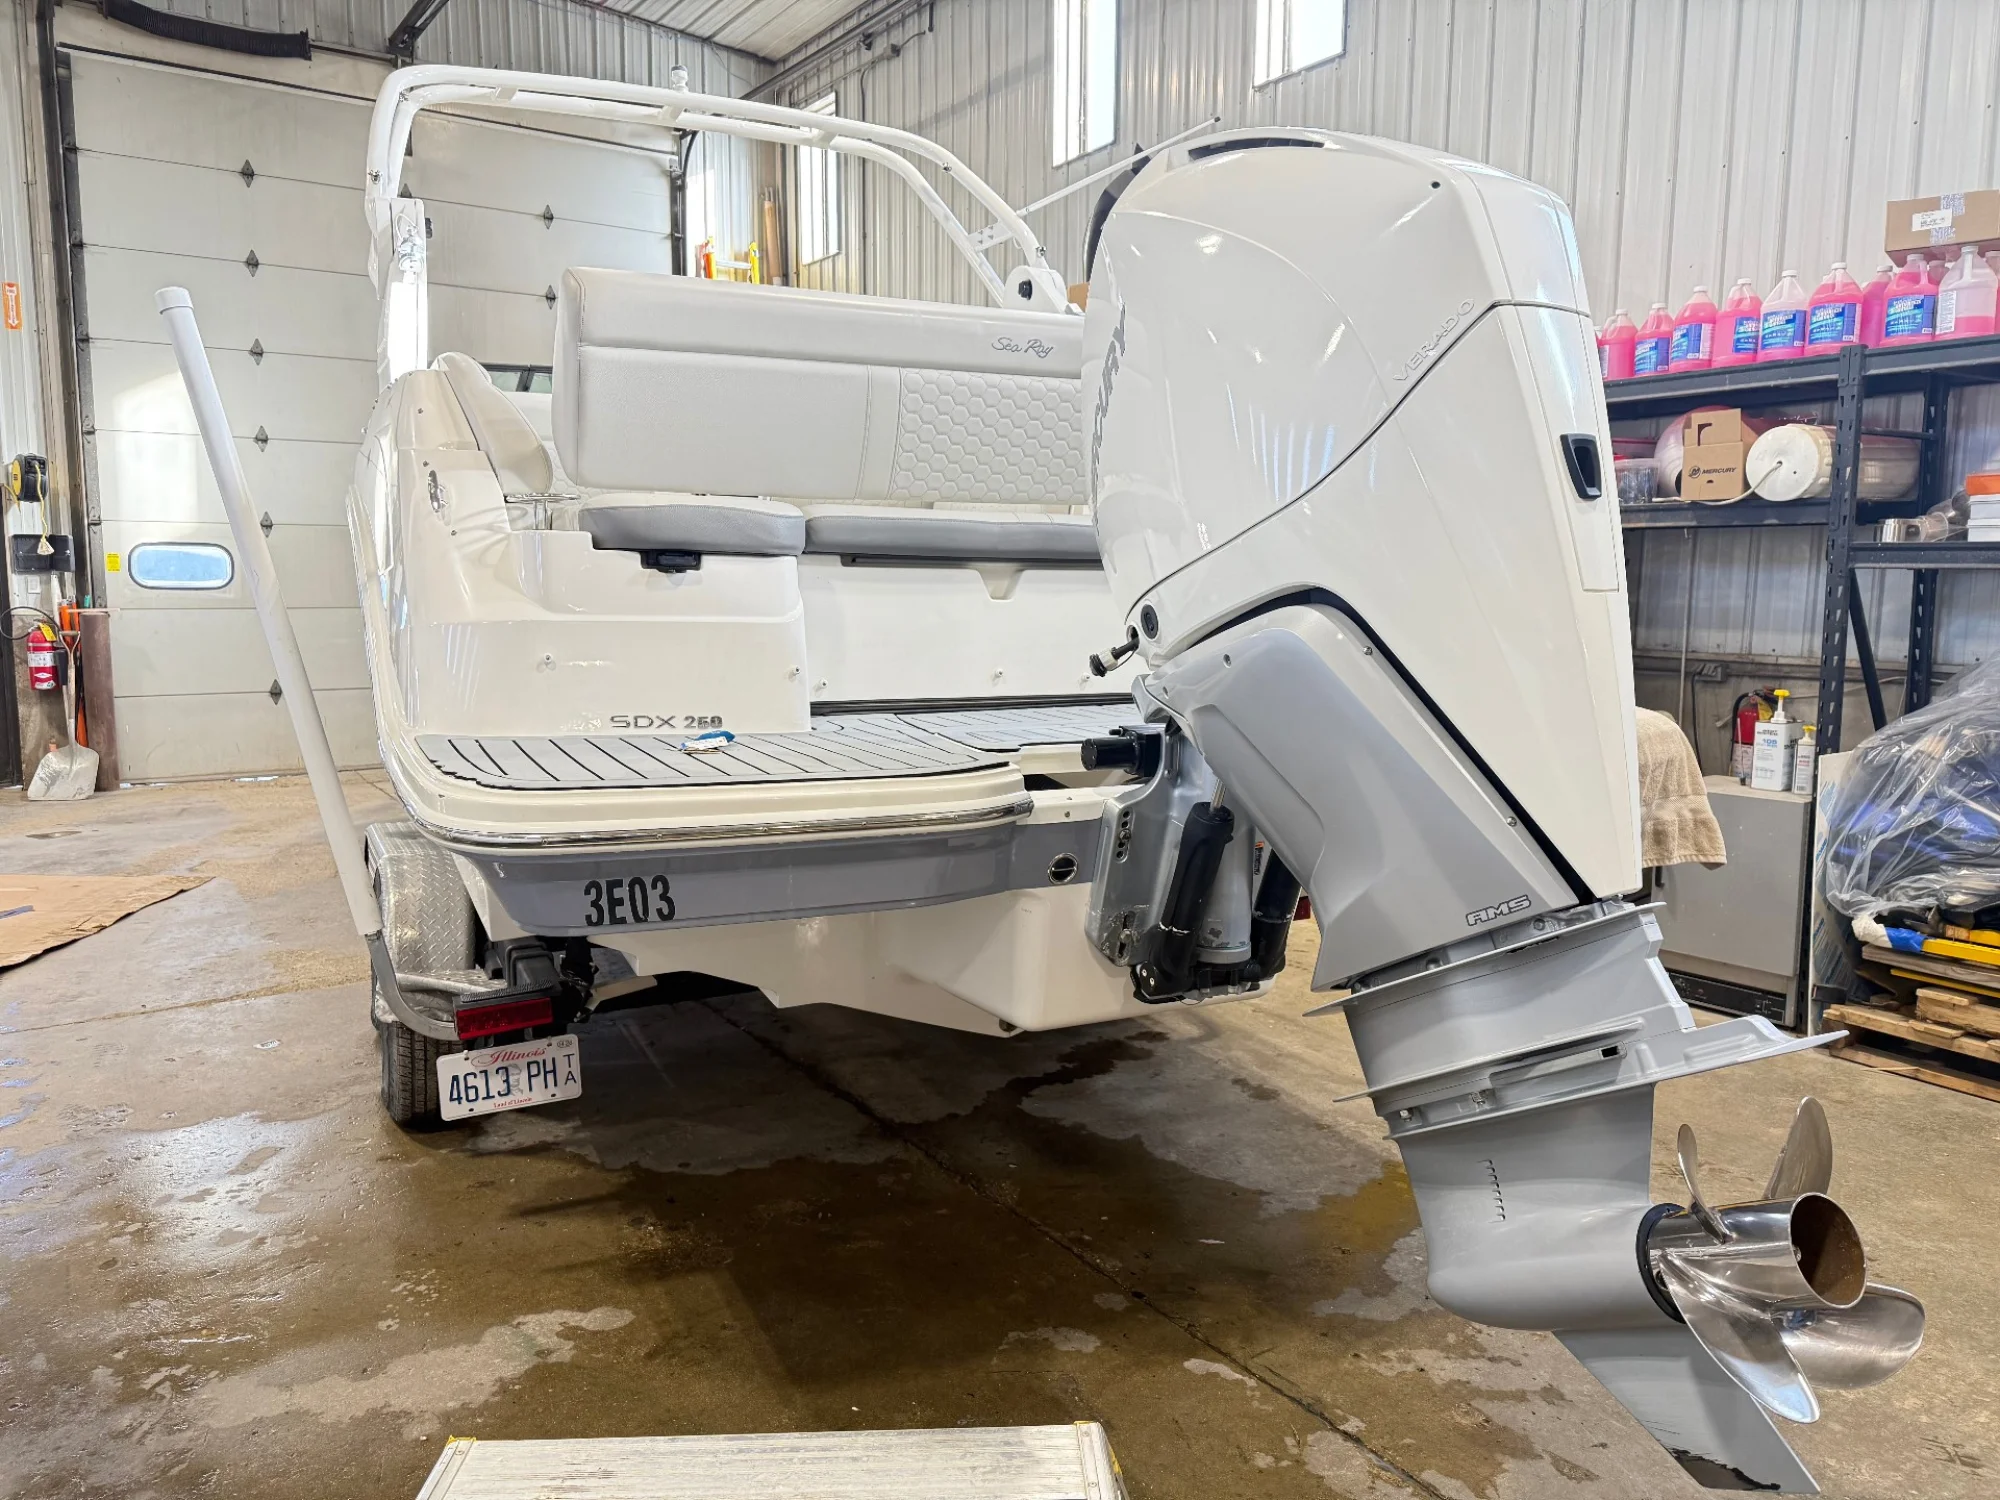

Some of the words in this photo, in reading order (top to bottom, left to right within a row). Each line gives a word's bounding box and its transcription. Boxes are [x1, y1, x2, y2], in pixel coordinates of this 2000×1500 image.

[991, 336, 1022, 352] Sea
[1024, 338, 1054, 359] Ray
[1392, 298, 1475, 381] VERADO
[1091, 302, 1126, 537] RCURY
[609, 715, 677, 729] SDX
[583, 874, 676, 927] 3E03
[1465, 894, 1532, 926] AMS
[471, 1047, 547, 1067] Illinois
[449, 1066, 511, 1105] 4613
[526, 1057, 558, 1092] PH
